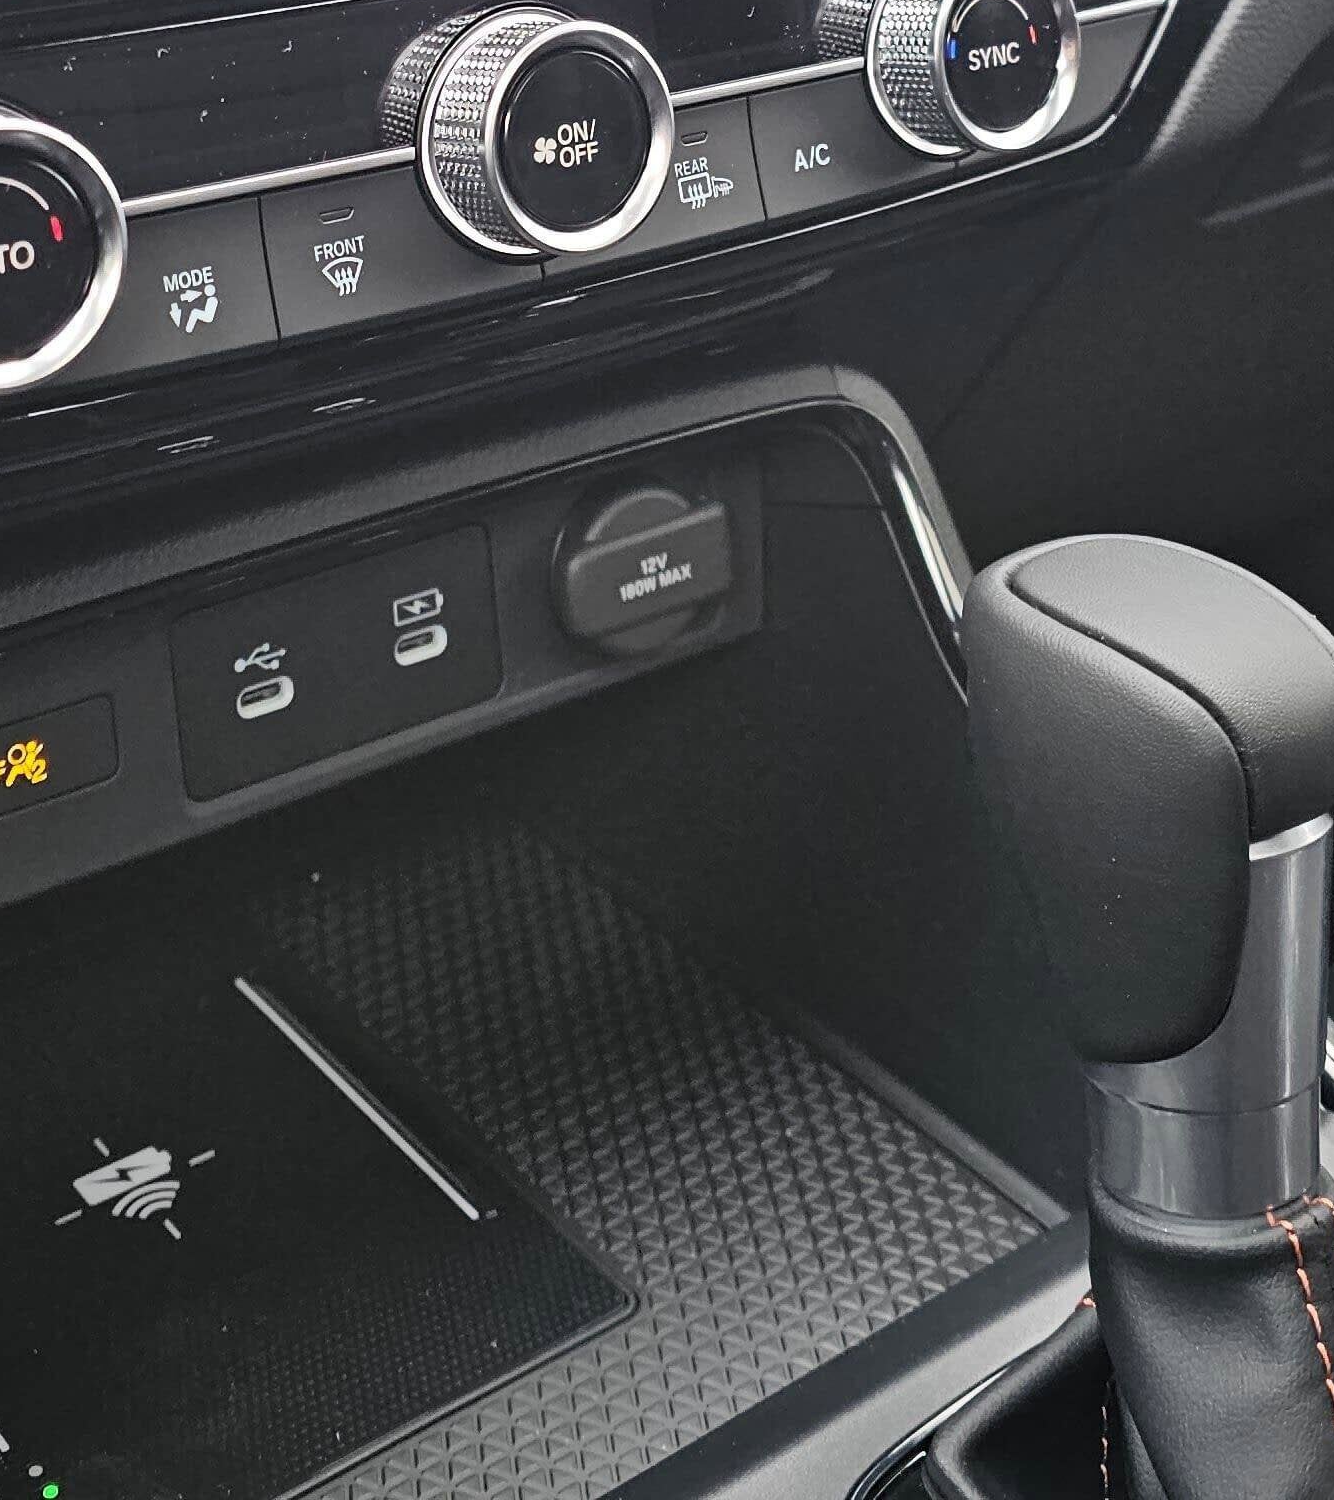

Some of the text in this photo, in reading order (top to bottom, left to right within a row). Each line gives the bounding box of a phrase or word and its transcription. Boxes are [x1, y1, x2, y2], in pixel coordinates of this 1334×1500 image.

[968, 42, 1020, 71] SYNC
[557, 118, 597, 143] ON/
[559, 140, 599, 168] OFF
[673, 156, 709, 178] REAR
[794, 143, 831, 173] A/C
[313, 235, 366, 262] FRONT
[162, 266, 214, 293] MODE
[640, 552, 668, 575] 12V
[659, 563, 692, 588] MAX
